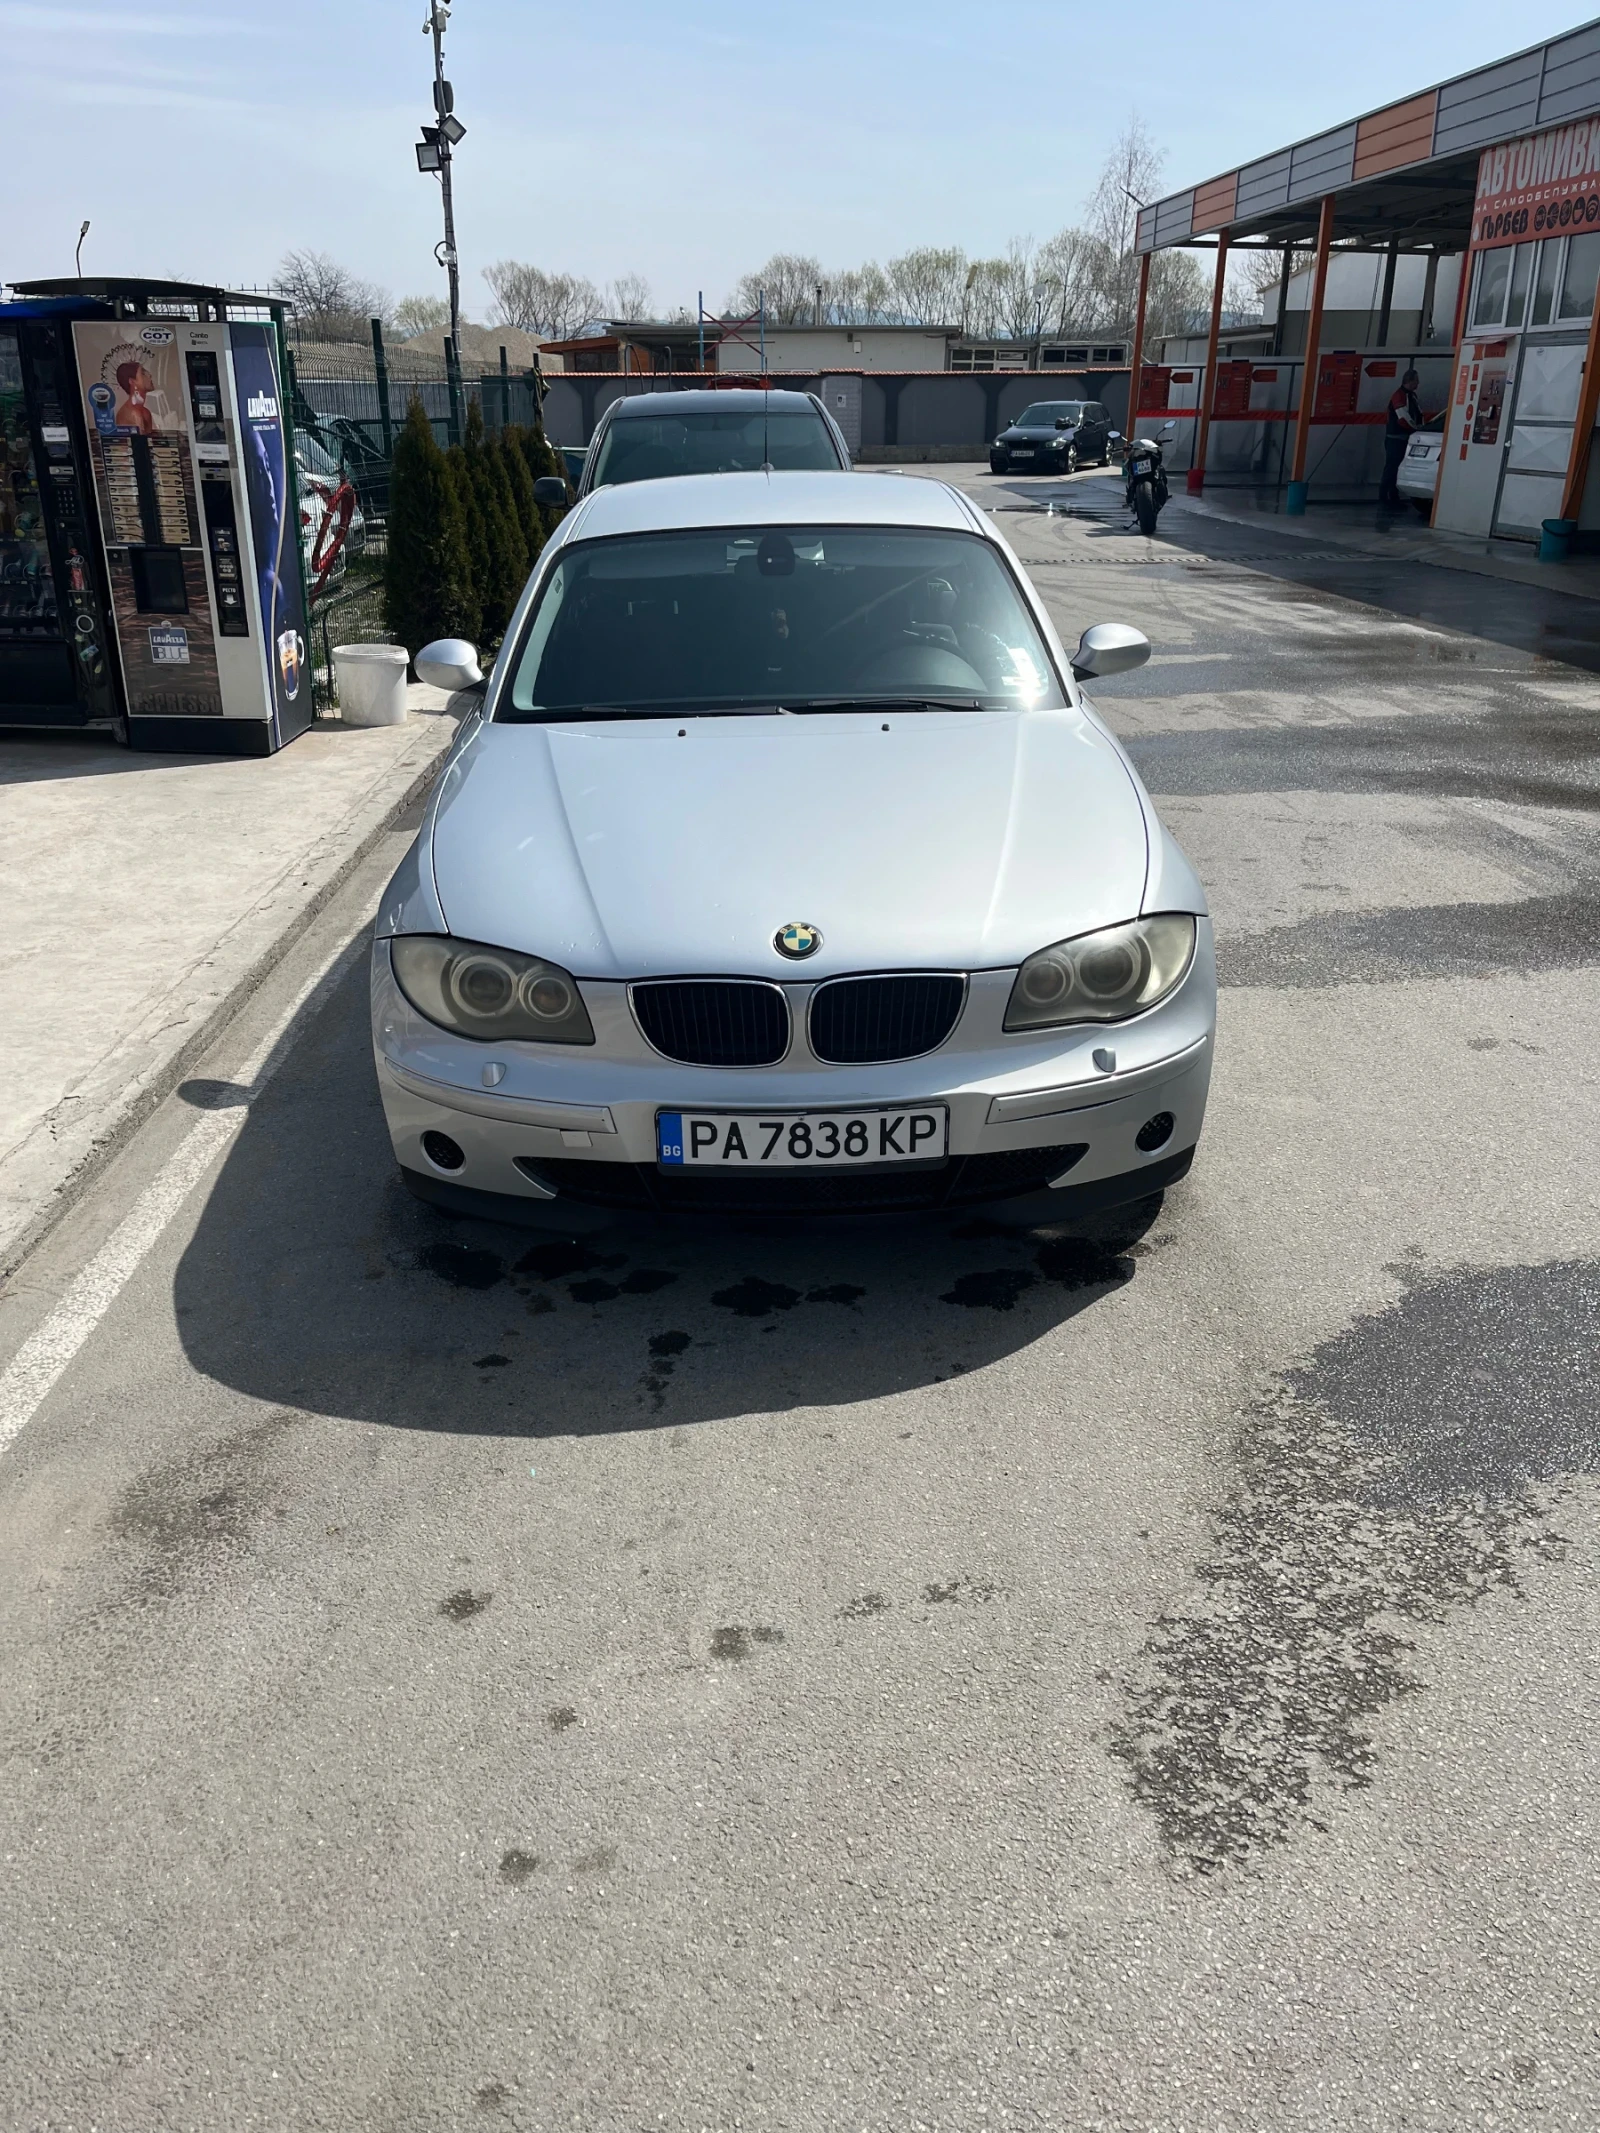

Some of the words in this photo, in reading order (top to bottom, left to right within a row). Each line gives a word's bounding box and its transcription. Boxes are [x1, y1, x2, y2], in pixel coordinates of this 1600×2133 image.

[1477, 117, 1600, 199] АВТОМИВК
[1475, 204, 1488, 213] НА
[1494, 179, 1600, 209] САМООБСЛУЖВА
[189, 331, 209, 339] Canto
[153, 633, 185, 644] LAVAZZA
[152, 646, 189, 660] BLUE
[131, 691, 222, 713] ESPRESSO
[662, 1145, 681, 1157] BG
